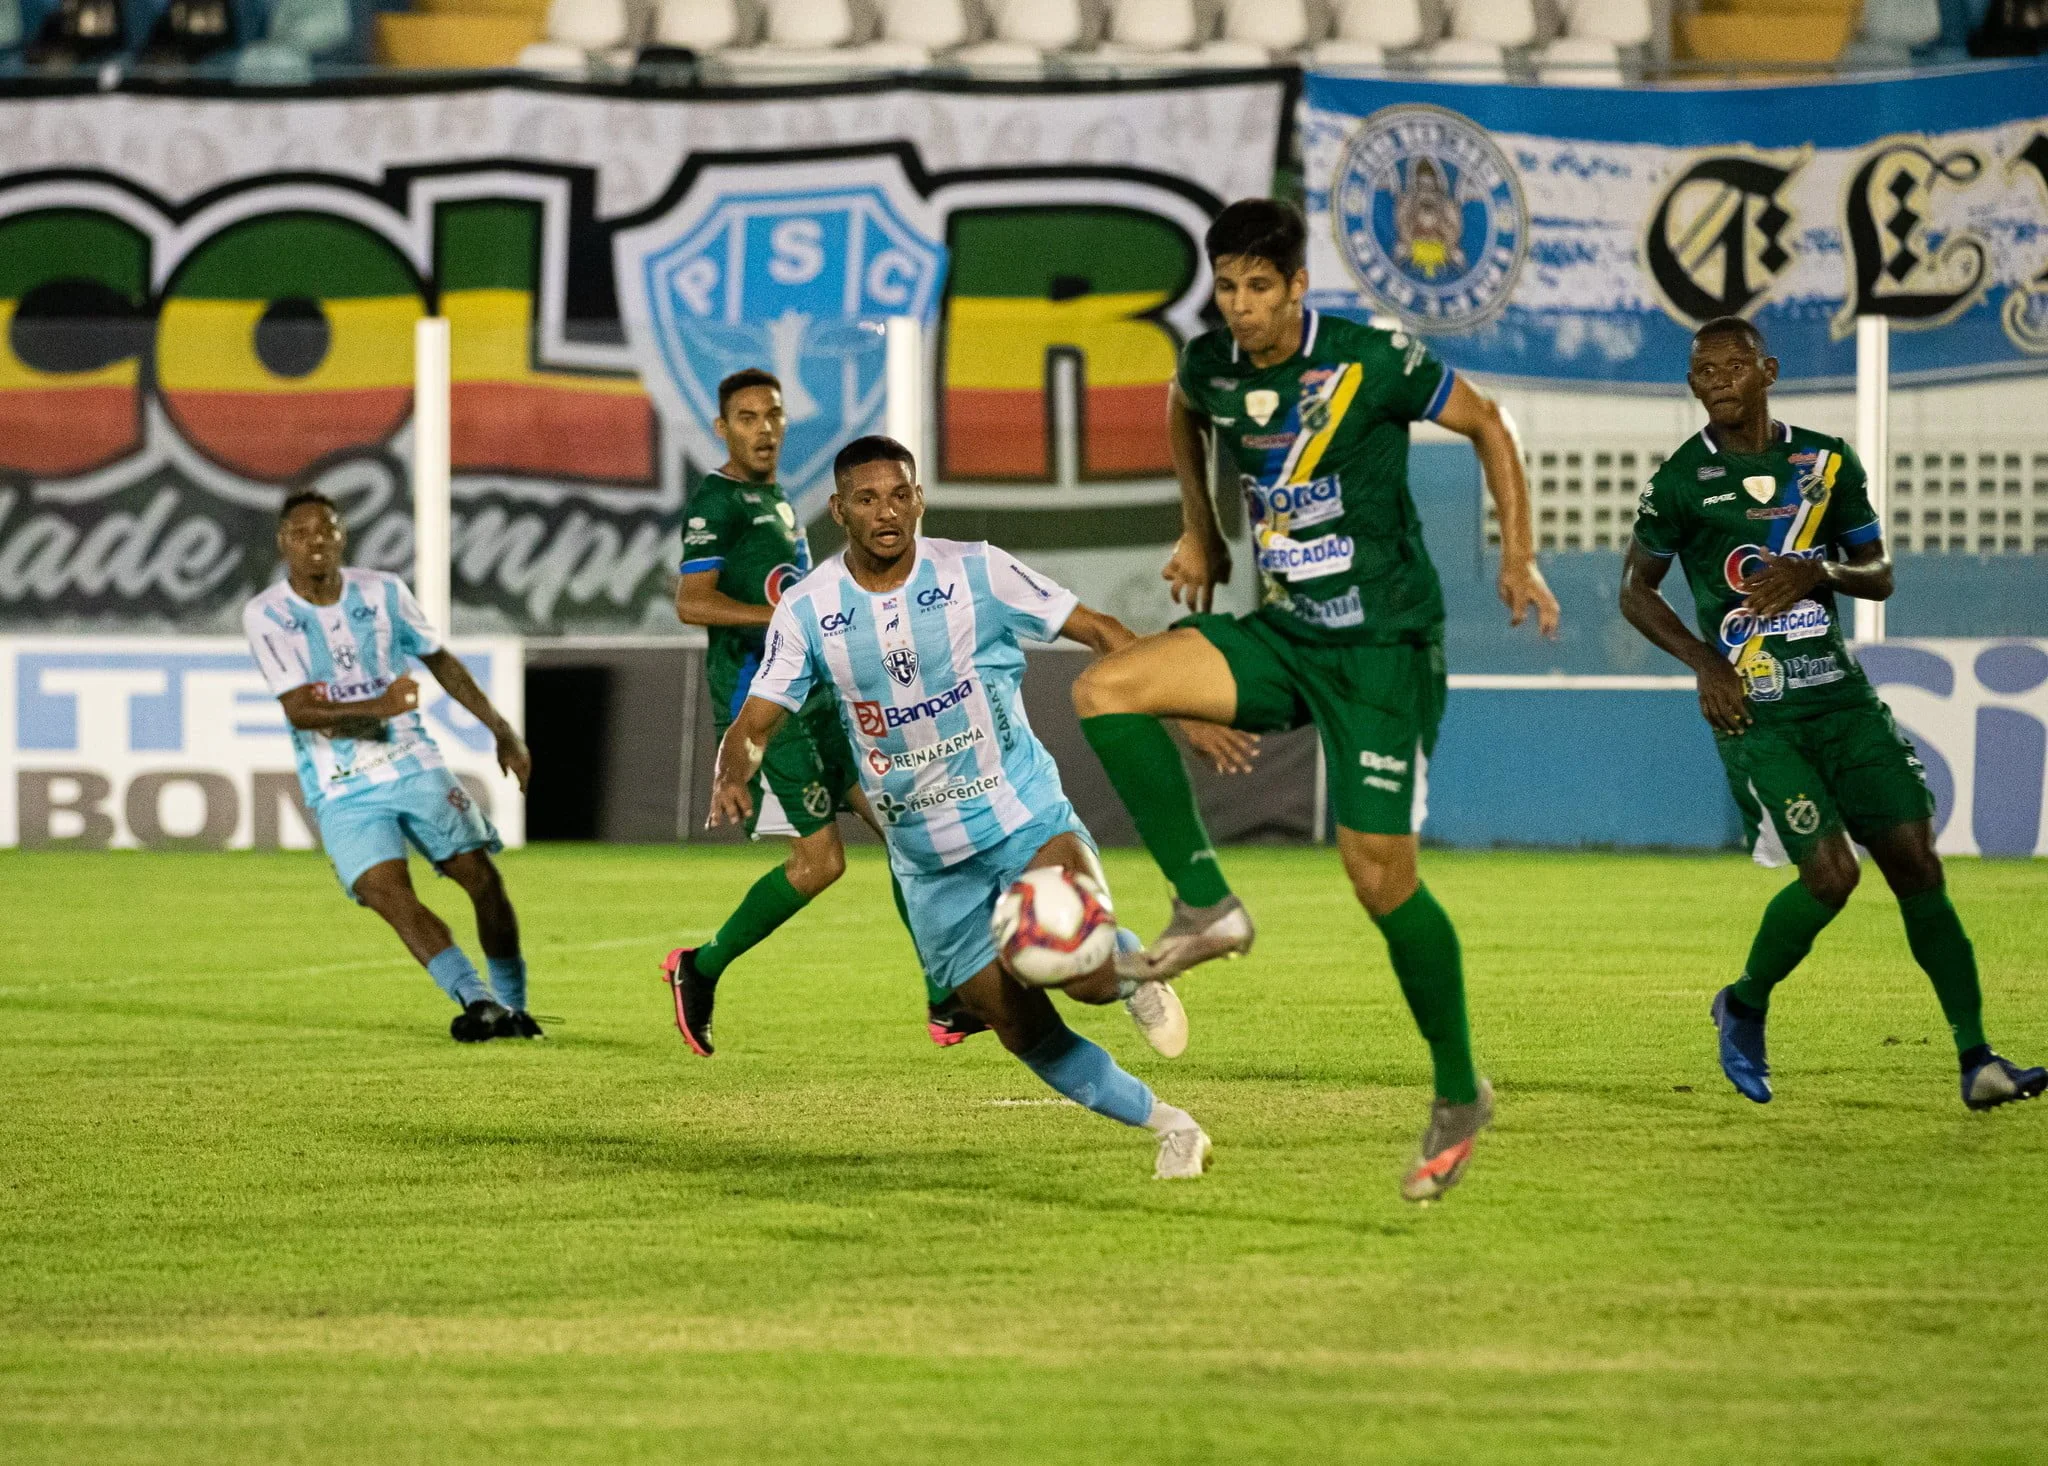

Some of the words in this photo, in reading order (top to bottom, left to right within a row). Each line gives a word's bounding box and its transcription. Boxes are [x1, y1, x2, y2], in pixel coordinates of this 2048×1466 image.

[917, 583, 955, 607] GAV
[920, 600, 958, 614] RESORTS
[820, 607, 856, 631] GAV
[823, 625, 857, 638] RESORTS
[894, 727, 984, 769] REINAFARMA
[910, 775, 999, 812] fisiocenter
